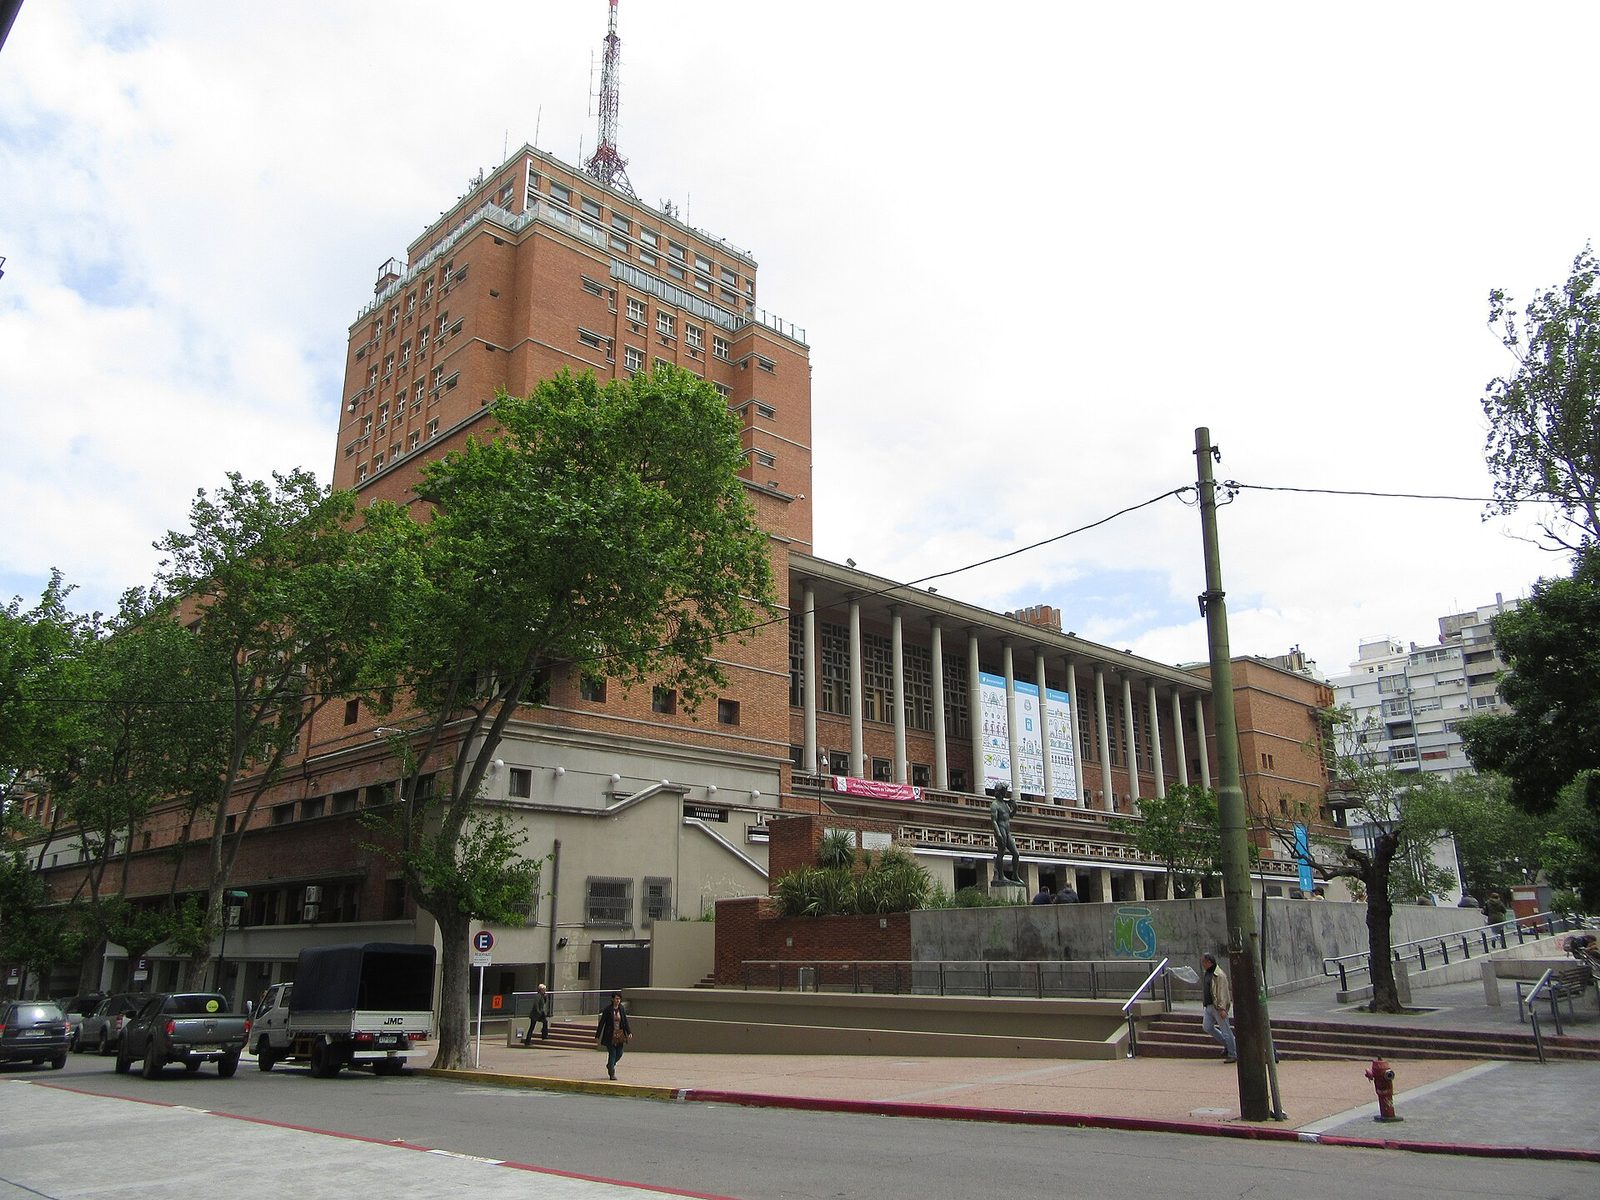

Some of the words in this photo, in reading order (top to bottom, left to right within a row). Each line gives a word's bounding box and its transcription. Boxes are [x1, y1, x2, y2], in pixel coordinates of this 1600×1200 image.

[479, 934, 489, 949] E
[138, 959, 146, 970] E
[384, 1017, 404, 1025] JMC
